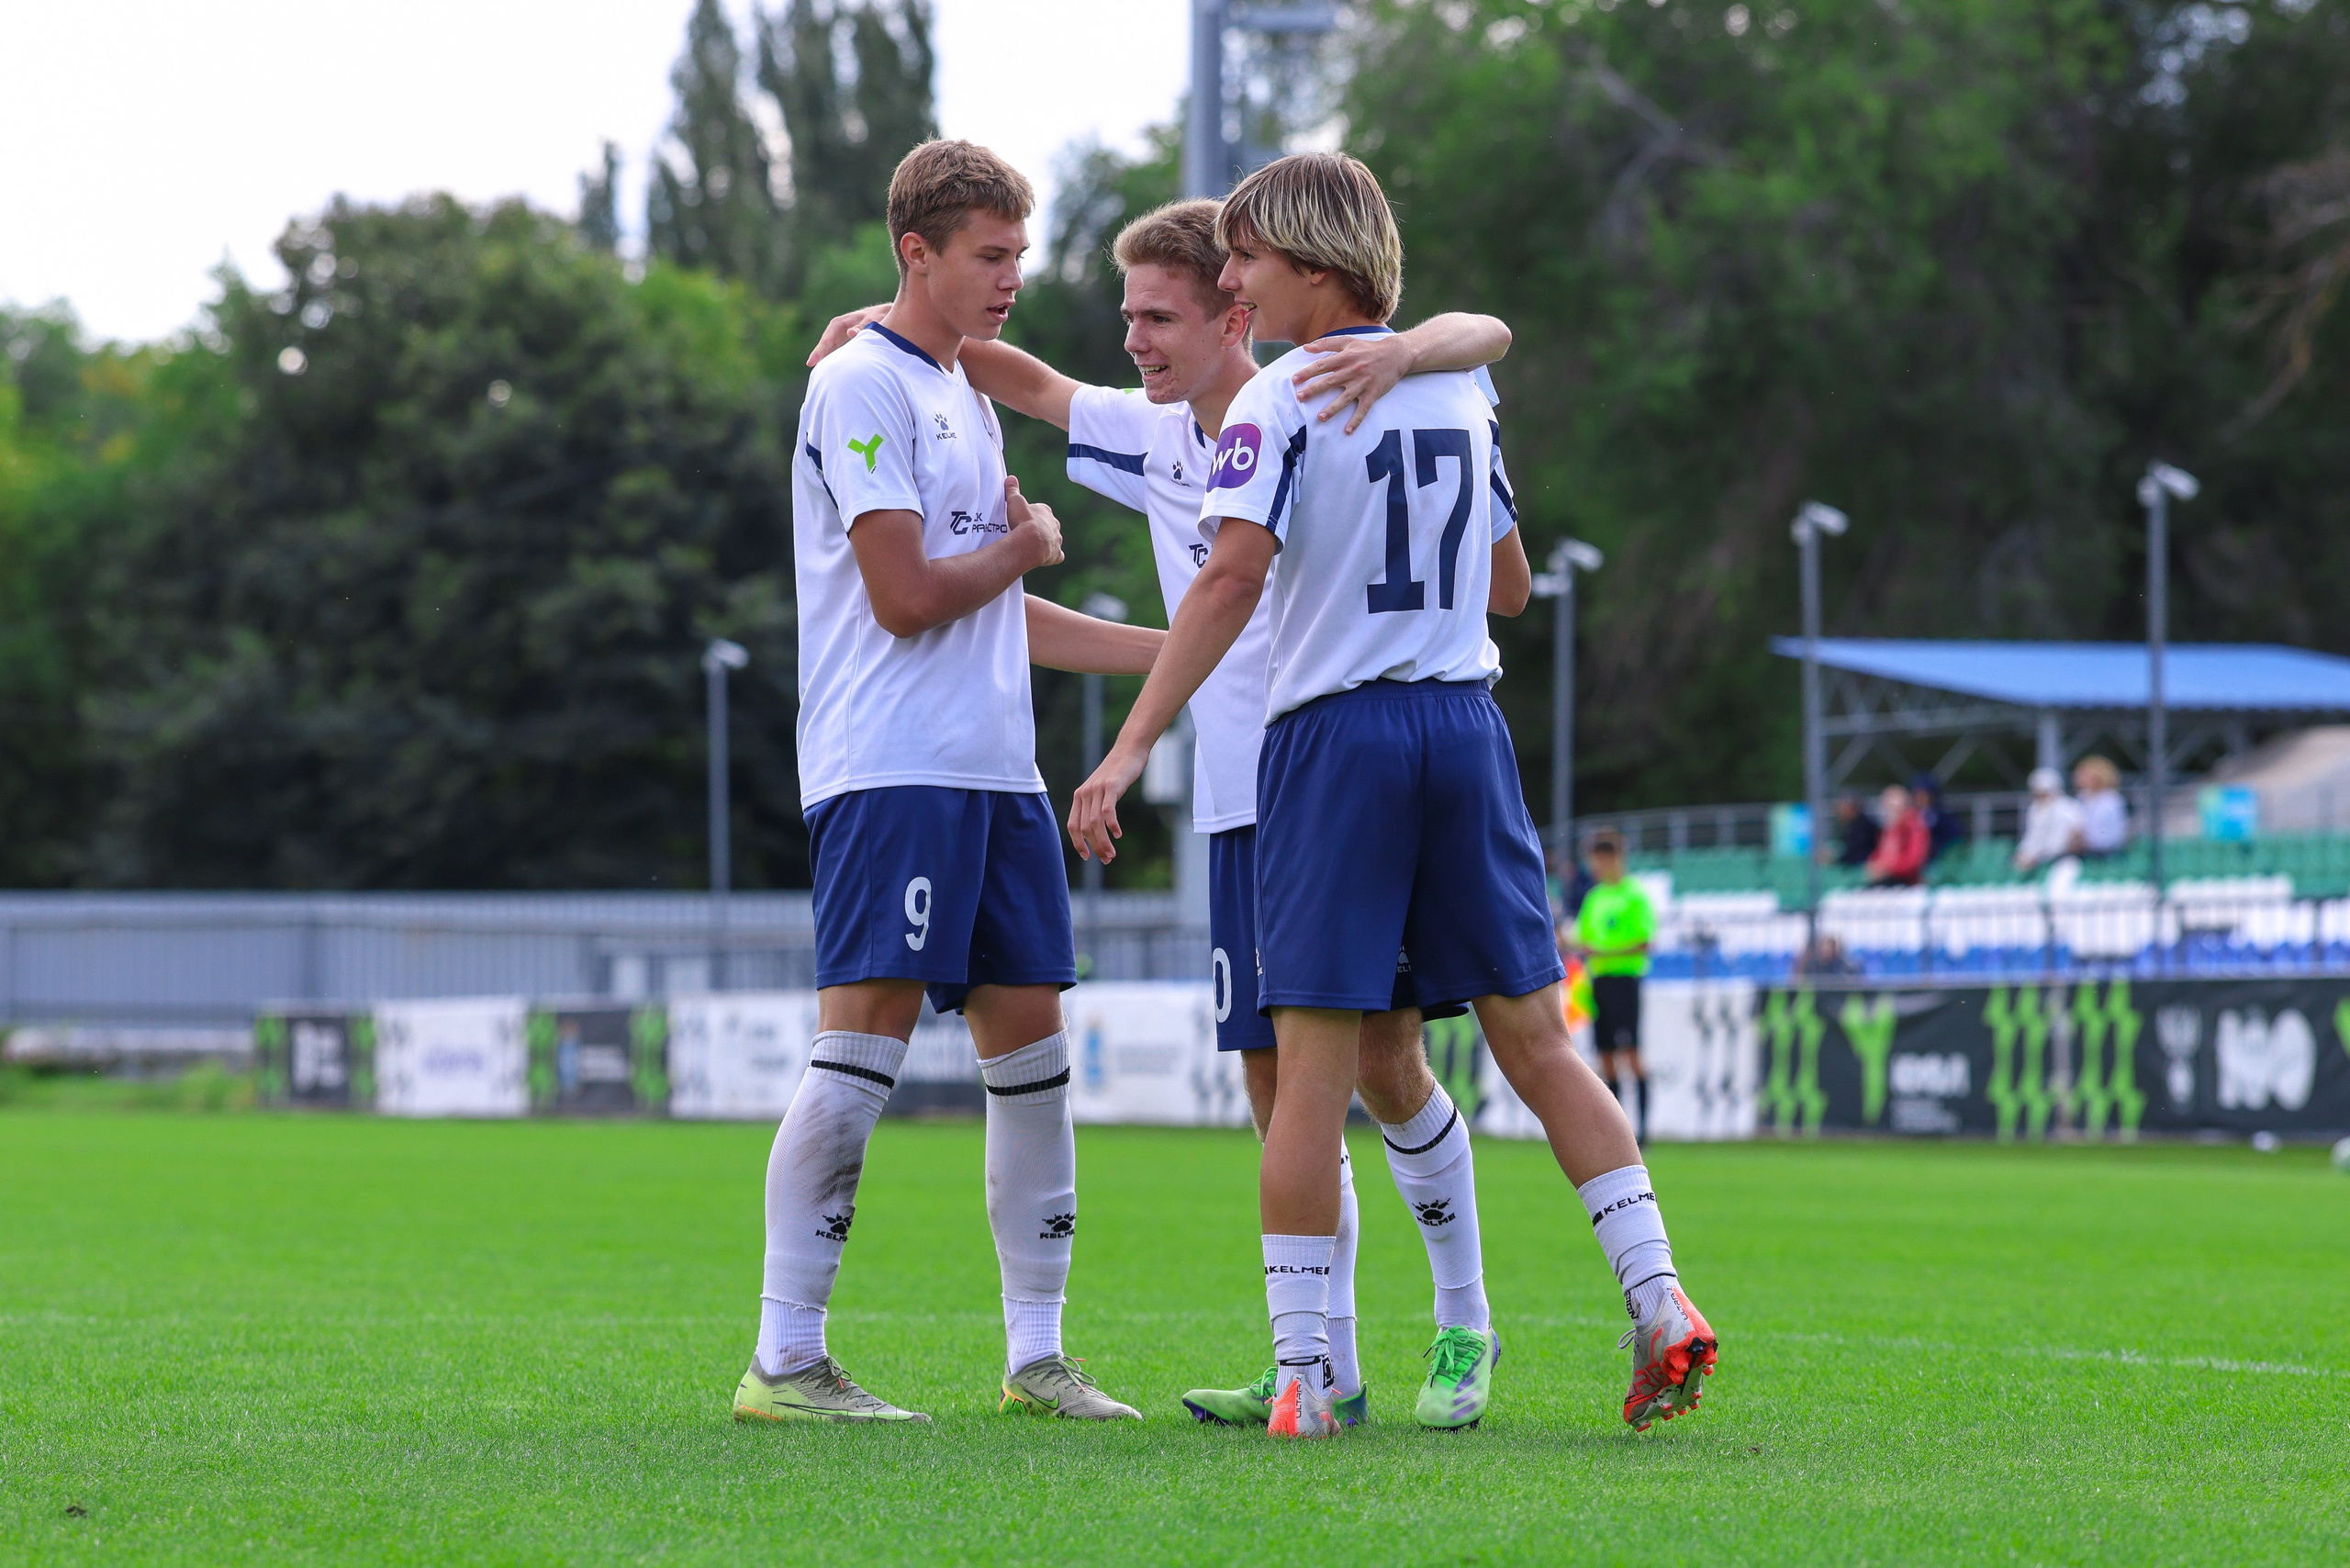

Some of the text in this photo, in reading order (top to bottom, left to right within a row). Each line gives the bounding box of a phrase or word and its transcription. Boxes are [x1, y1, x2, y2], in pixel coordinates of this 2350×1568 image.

[1212, 437, 1255, 476] wb
[1364, 429, 1473, 614] 17
[904, 876, 932, 951] 9
[1603, 1192, 1655, 1215] KELME
[1269, 1265, 1324, 1275] KELME
[1670, 1292, 1689, 1321] ULTRA
